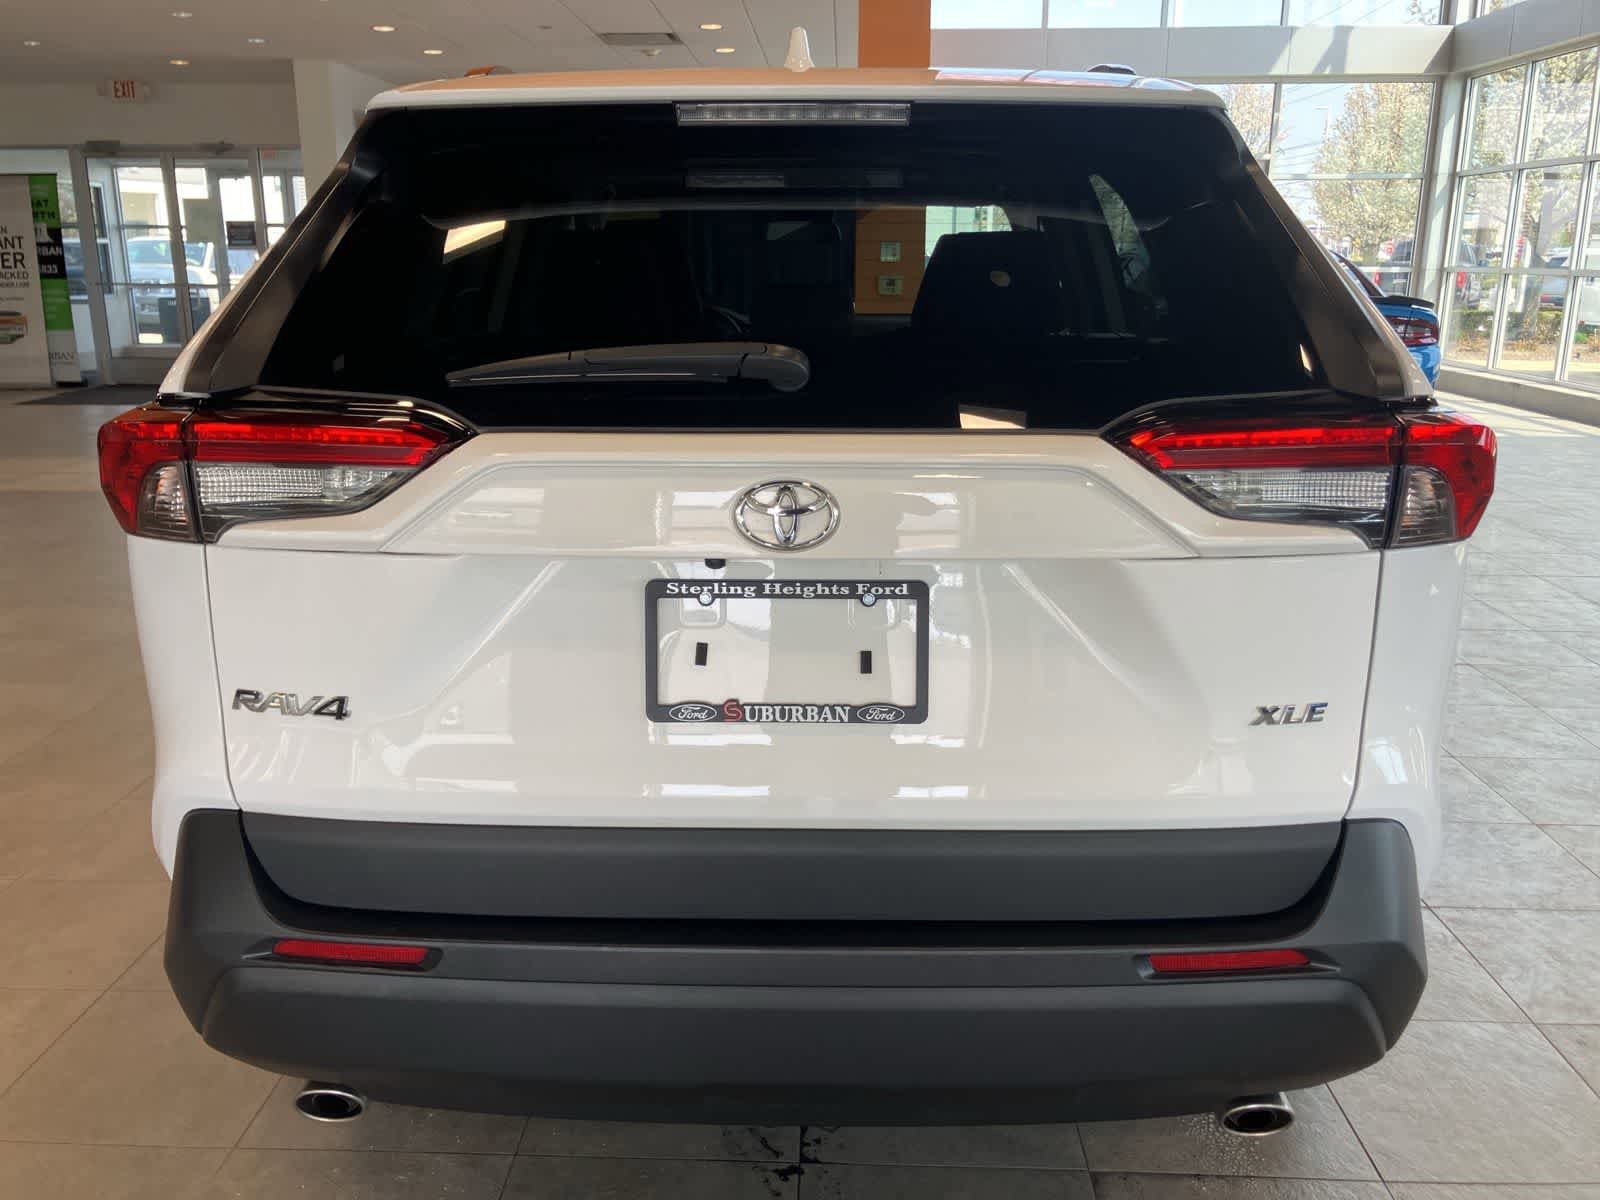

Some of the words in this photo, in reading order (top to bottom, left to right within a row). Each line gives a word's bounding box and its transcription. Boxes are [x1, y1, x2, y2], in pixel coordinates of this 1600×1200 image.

[114, 79, 136, 98] EXIT
[666, 582, 757, 598] Sterling
[762, 583, 850, 598] Heights
[855, 583, 909, 596] Ford
[232, 688, 351, 720] RAV4
[677, 707, 710, 720] Ford
[723, 699, 851, 723] SUBURBAN
[865, 707, 898, 721] Ford
[1249, 702, 1328, 726] XLE
